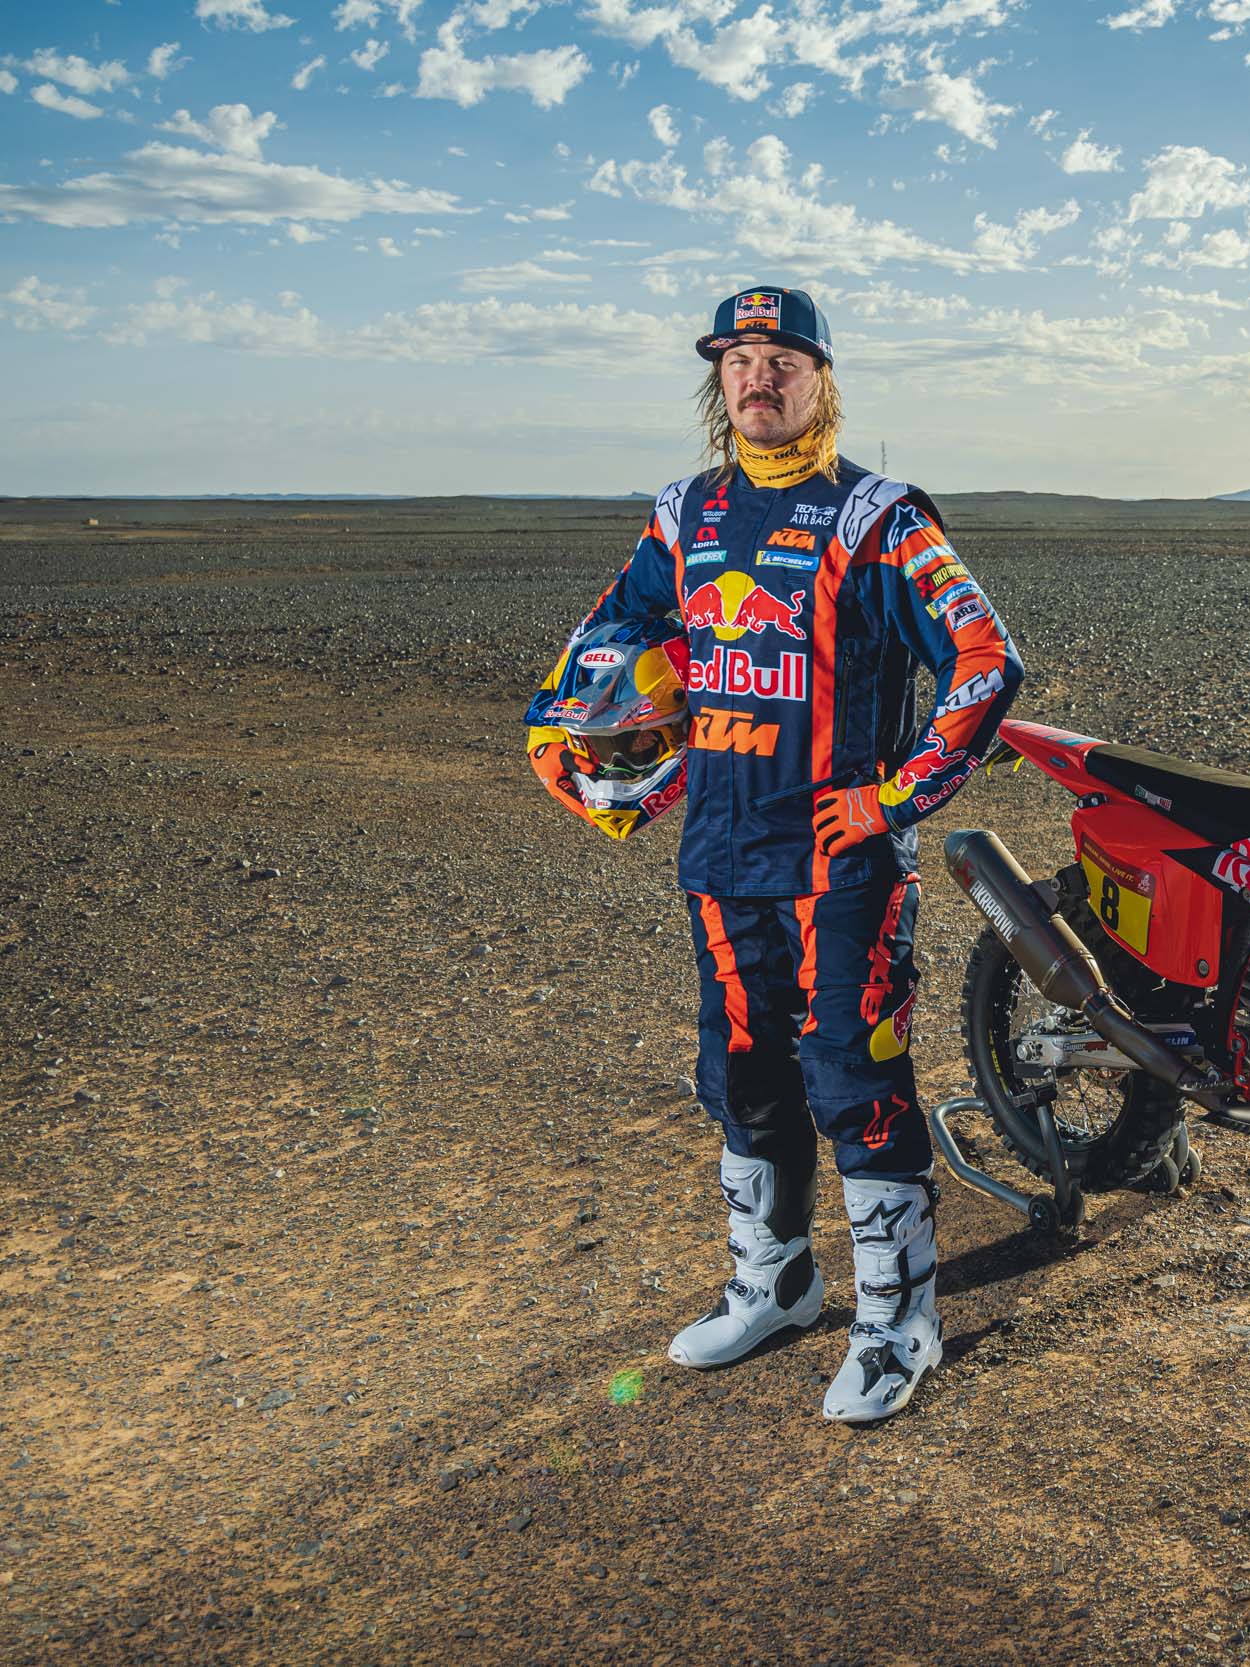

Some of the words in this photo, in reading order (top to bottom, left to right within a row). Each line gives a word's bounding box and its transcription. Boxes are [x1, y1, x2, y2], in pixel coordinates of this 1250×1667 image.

[795, 504, 817, 513] TECH
[692, 540, 719, 549] ADRIA
[767, 528, 816, 551] KTM
[772, 555, 814, 567] MICHELIN
[953, 603, 978, 622] ARB
[583, 653, 616, 663] BELL
[688, 645, 724, 694] ed
[725, 649, 807, 701] Bull
[935, 666, 1006, 720] KTM
[688, 707, 780, 757] KTM
[913, 781, 951, 812] Red
[1100, 875, 1120, 932] 8
